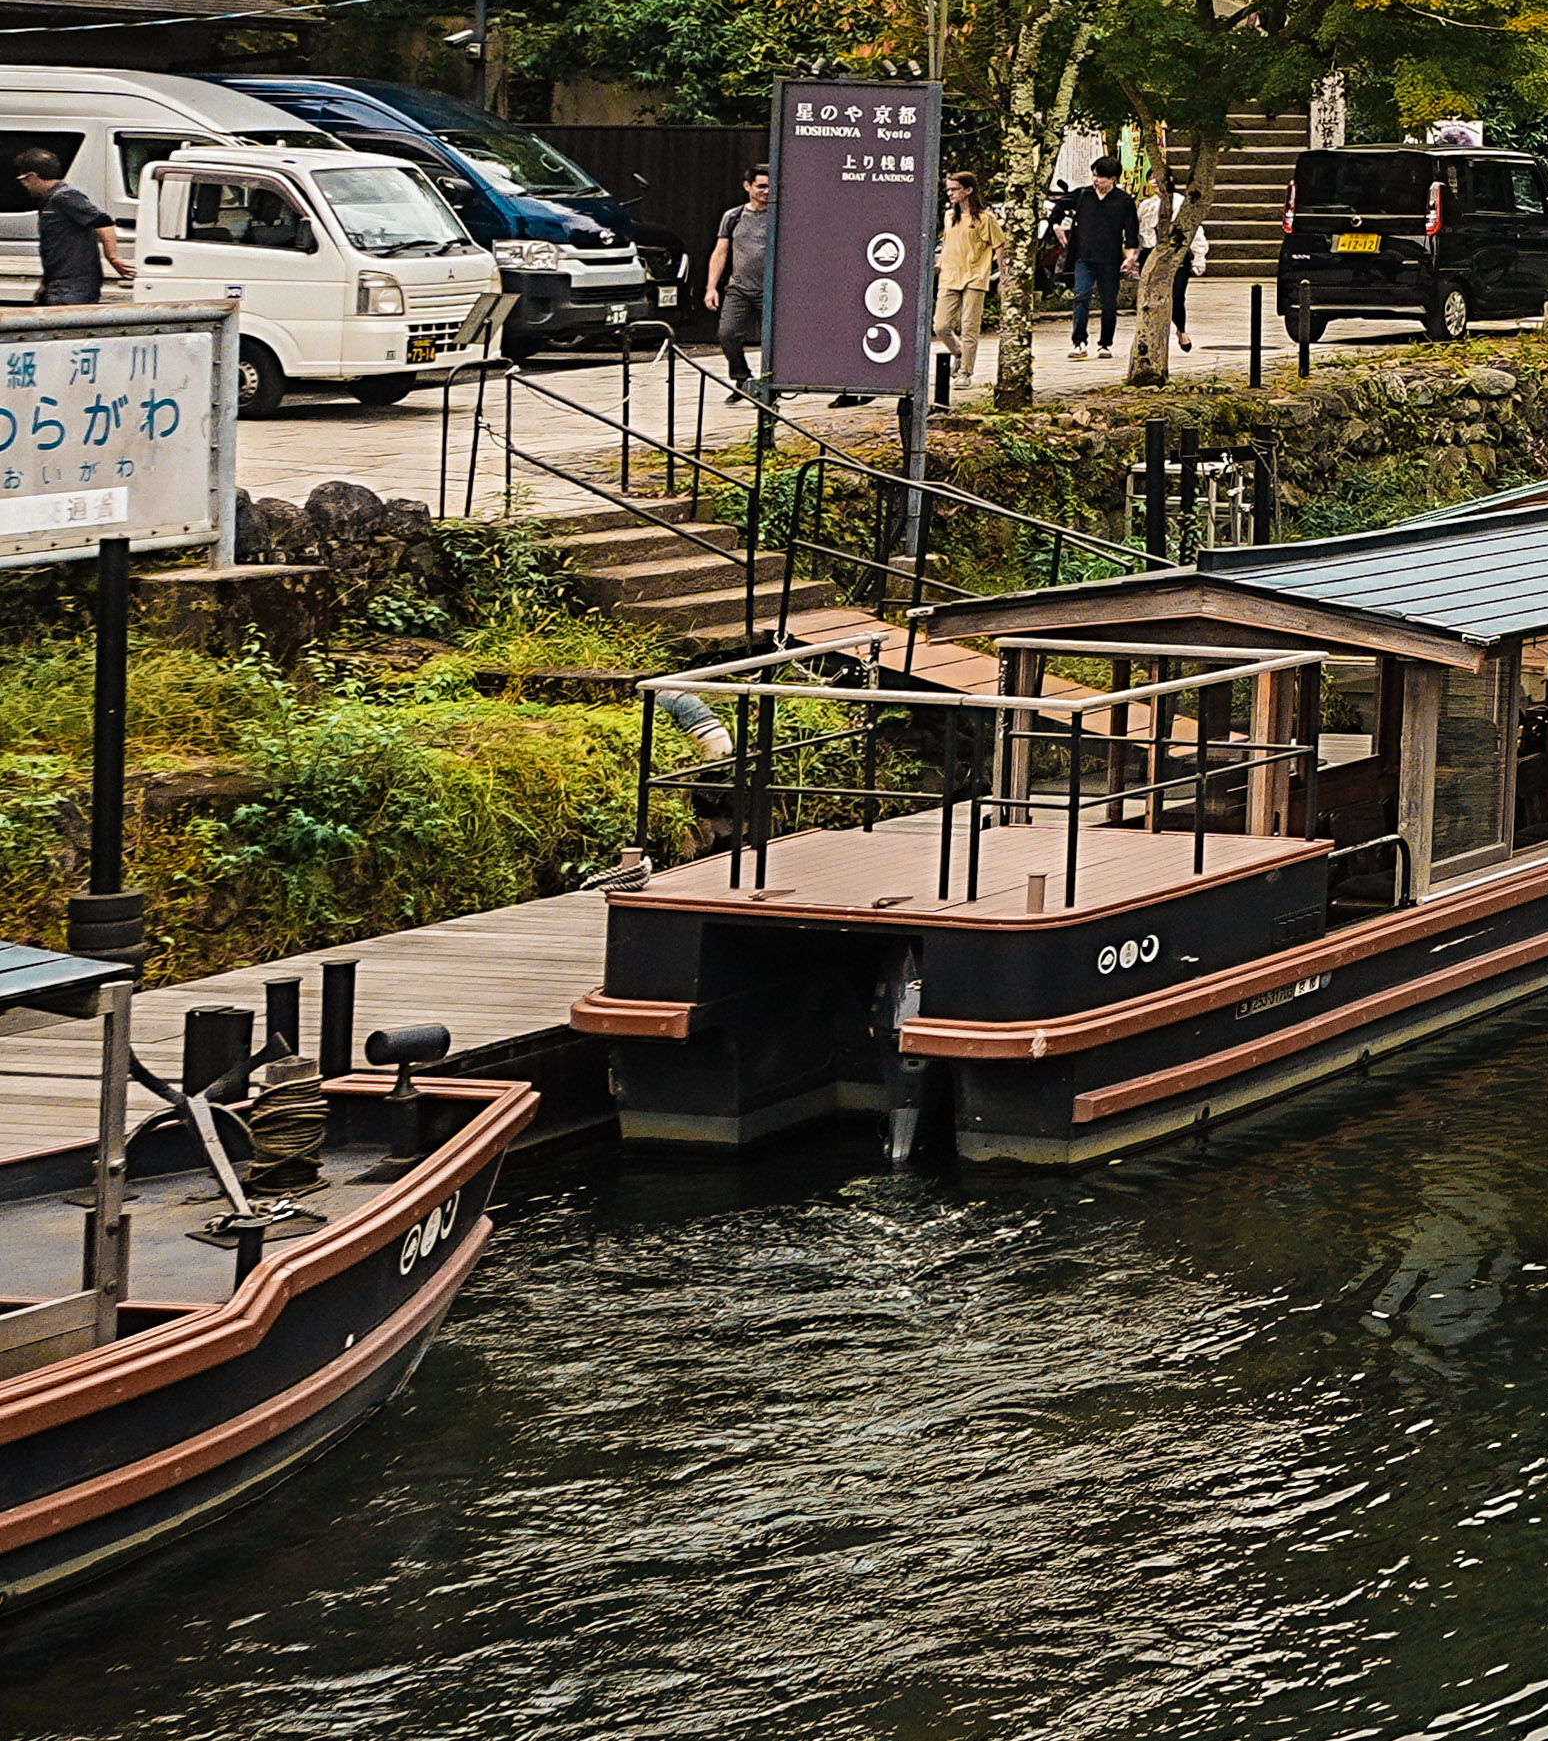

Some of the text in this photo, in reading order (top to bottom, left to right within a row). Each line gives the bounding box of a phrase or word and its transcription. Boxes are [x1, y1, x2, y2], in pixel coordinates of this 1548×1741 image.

[795, 125, 911, 141] HOSHINOYA Kyoto
[842, 172, 914, 182] BOAT LANDING
